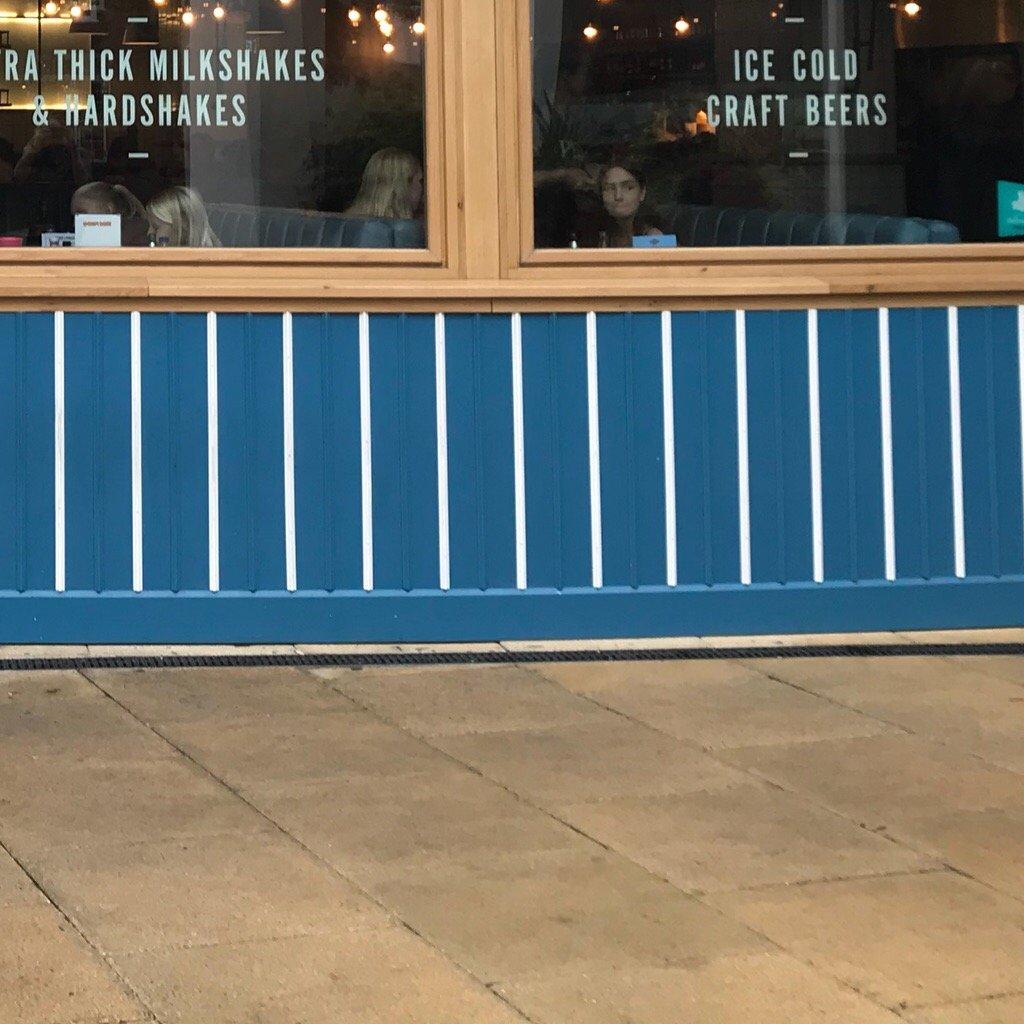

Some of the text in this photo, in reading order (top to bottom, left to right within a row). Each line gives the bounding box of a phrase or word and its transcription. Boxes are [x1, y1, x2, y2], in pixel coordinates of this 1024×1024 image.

[54, 49, 134, 81] THICK
[150, 49, 326, 81] MILKSHAKES
[734, 49, 858, 82] ICE COLD
[32, 94, 247, 127] & HARDSHAKES
[707, 94, 888, 127] CRAFT BEERS
